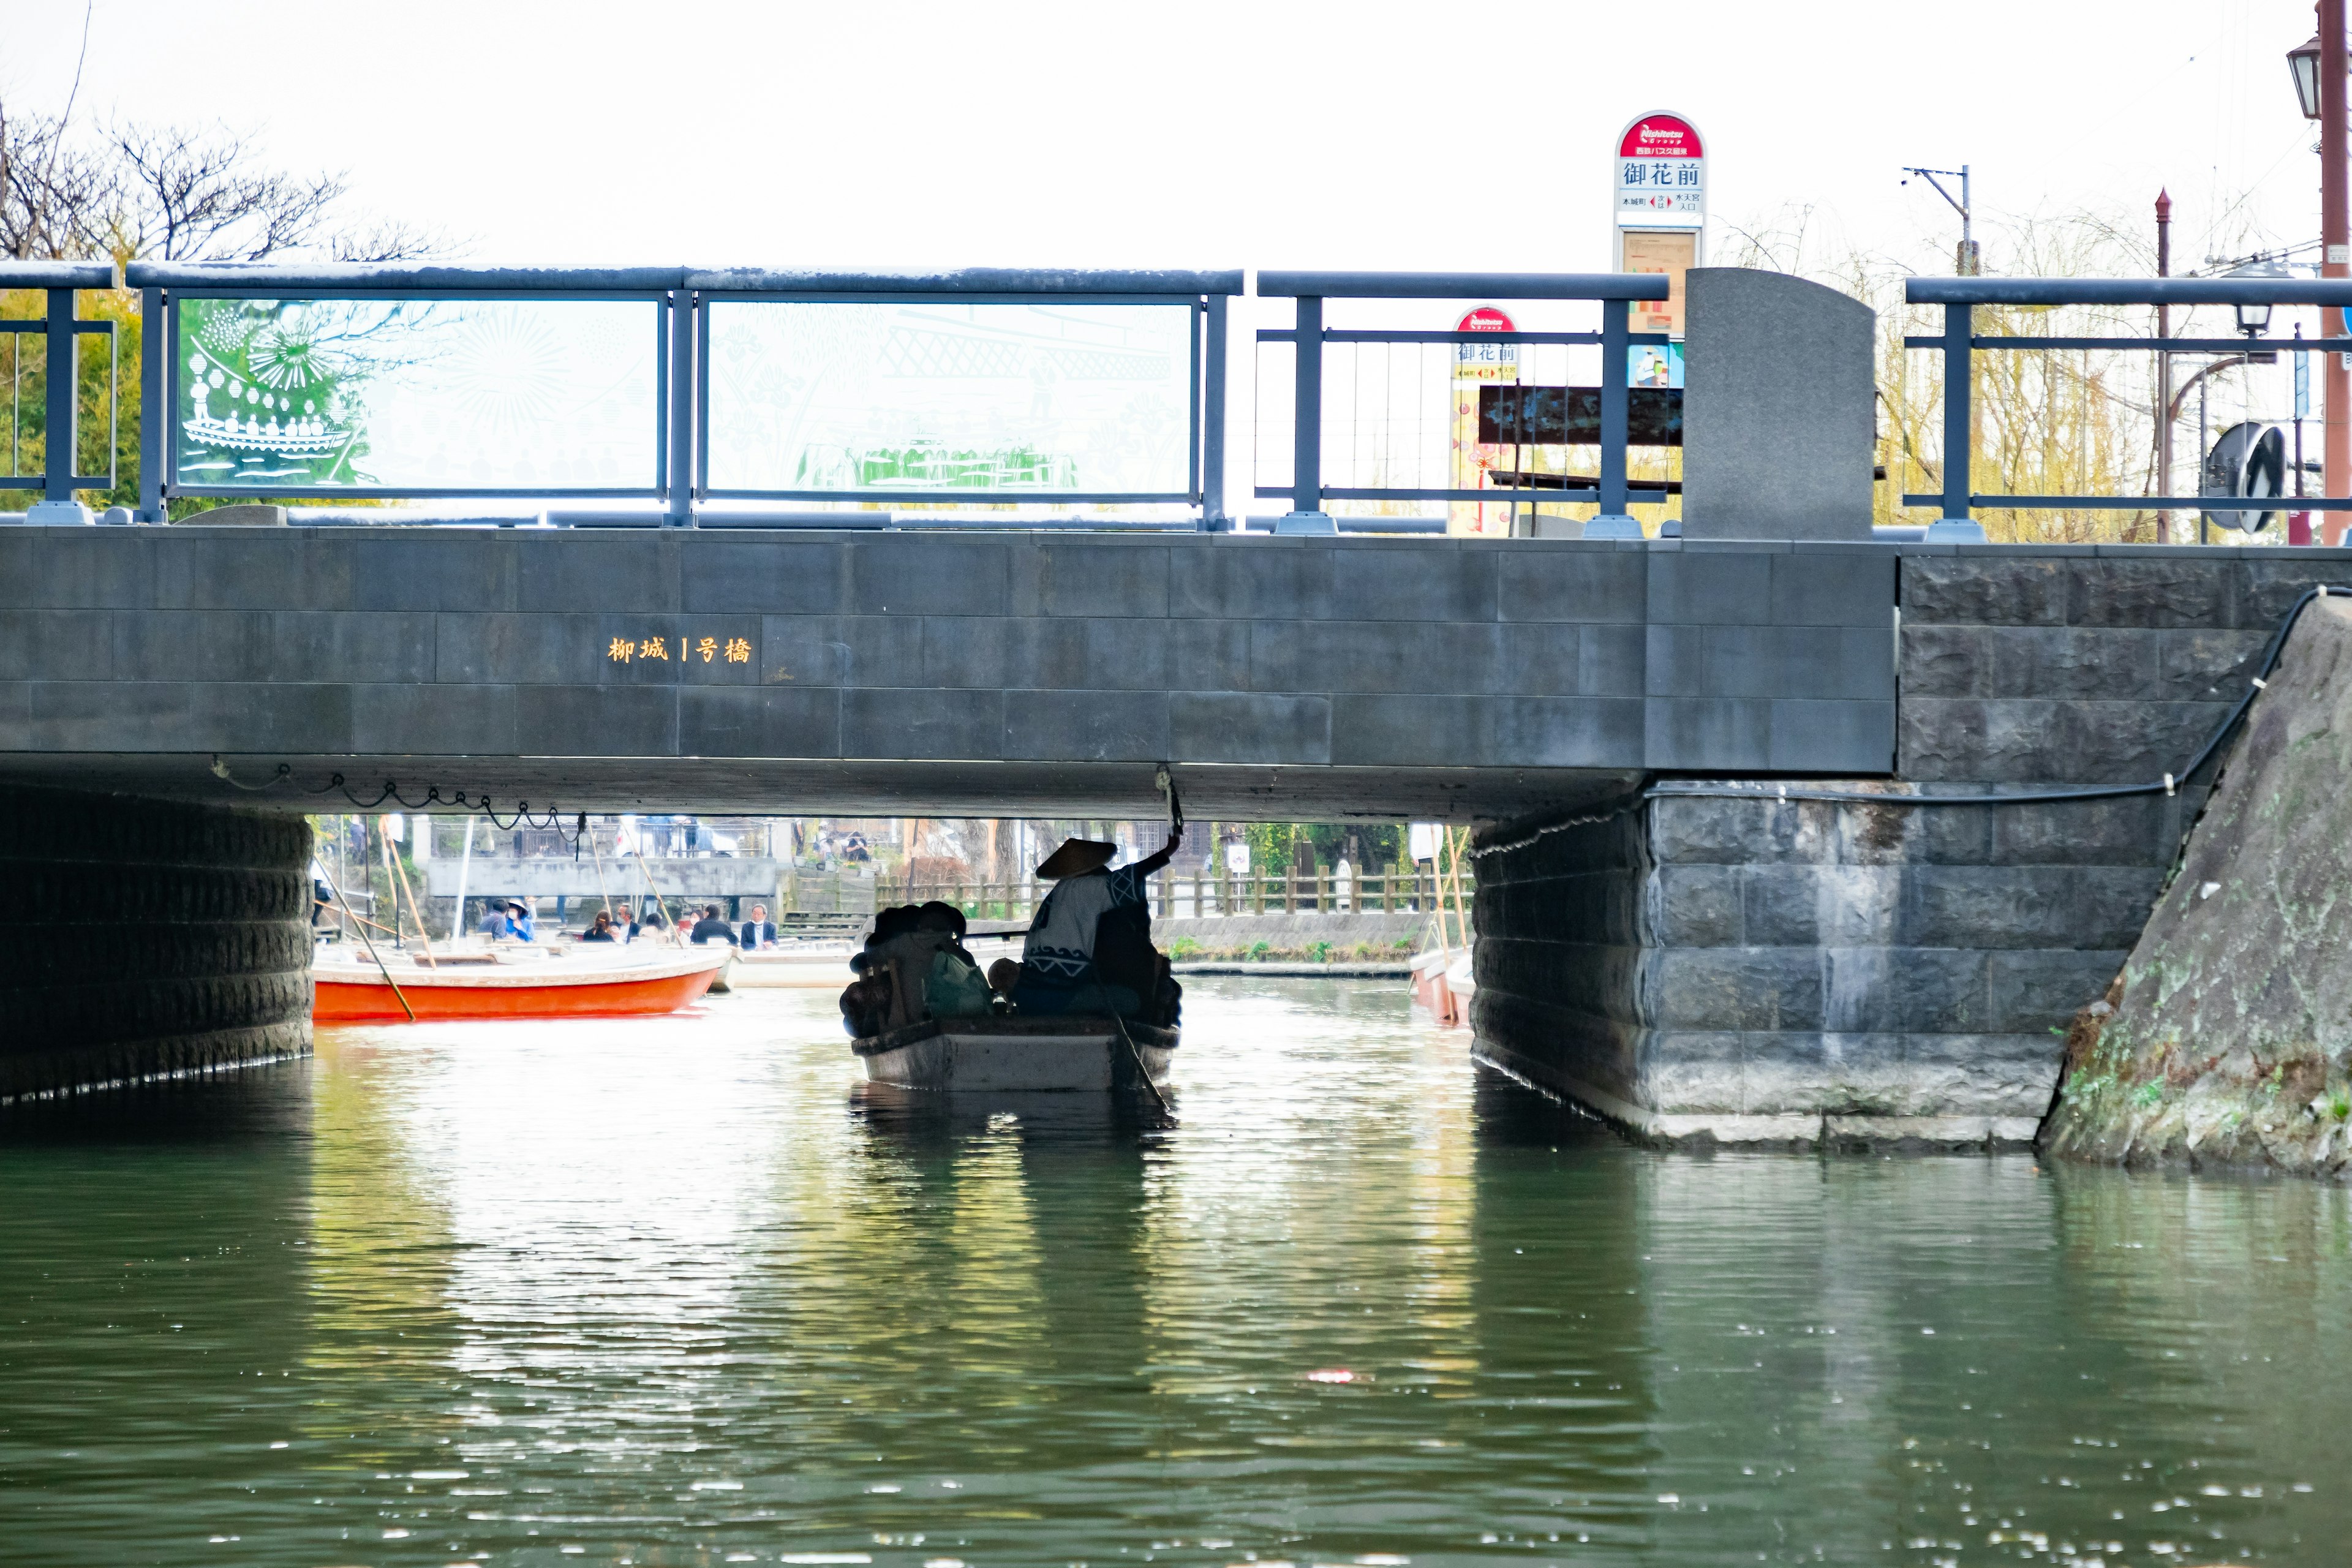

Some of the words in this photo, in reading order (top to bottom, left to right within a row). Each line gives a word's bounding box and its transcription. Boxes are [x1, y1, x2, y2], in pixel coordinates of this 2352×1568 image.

[1641, 127, 1684, 139] Nishitetsu
[1623, 162, 1700, 186] 御花前
[1657, 195, 1665, 209] 次は
[1458, 344, 1515, 361] 御花前
